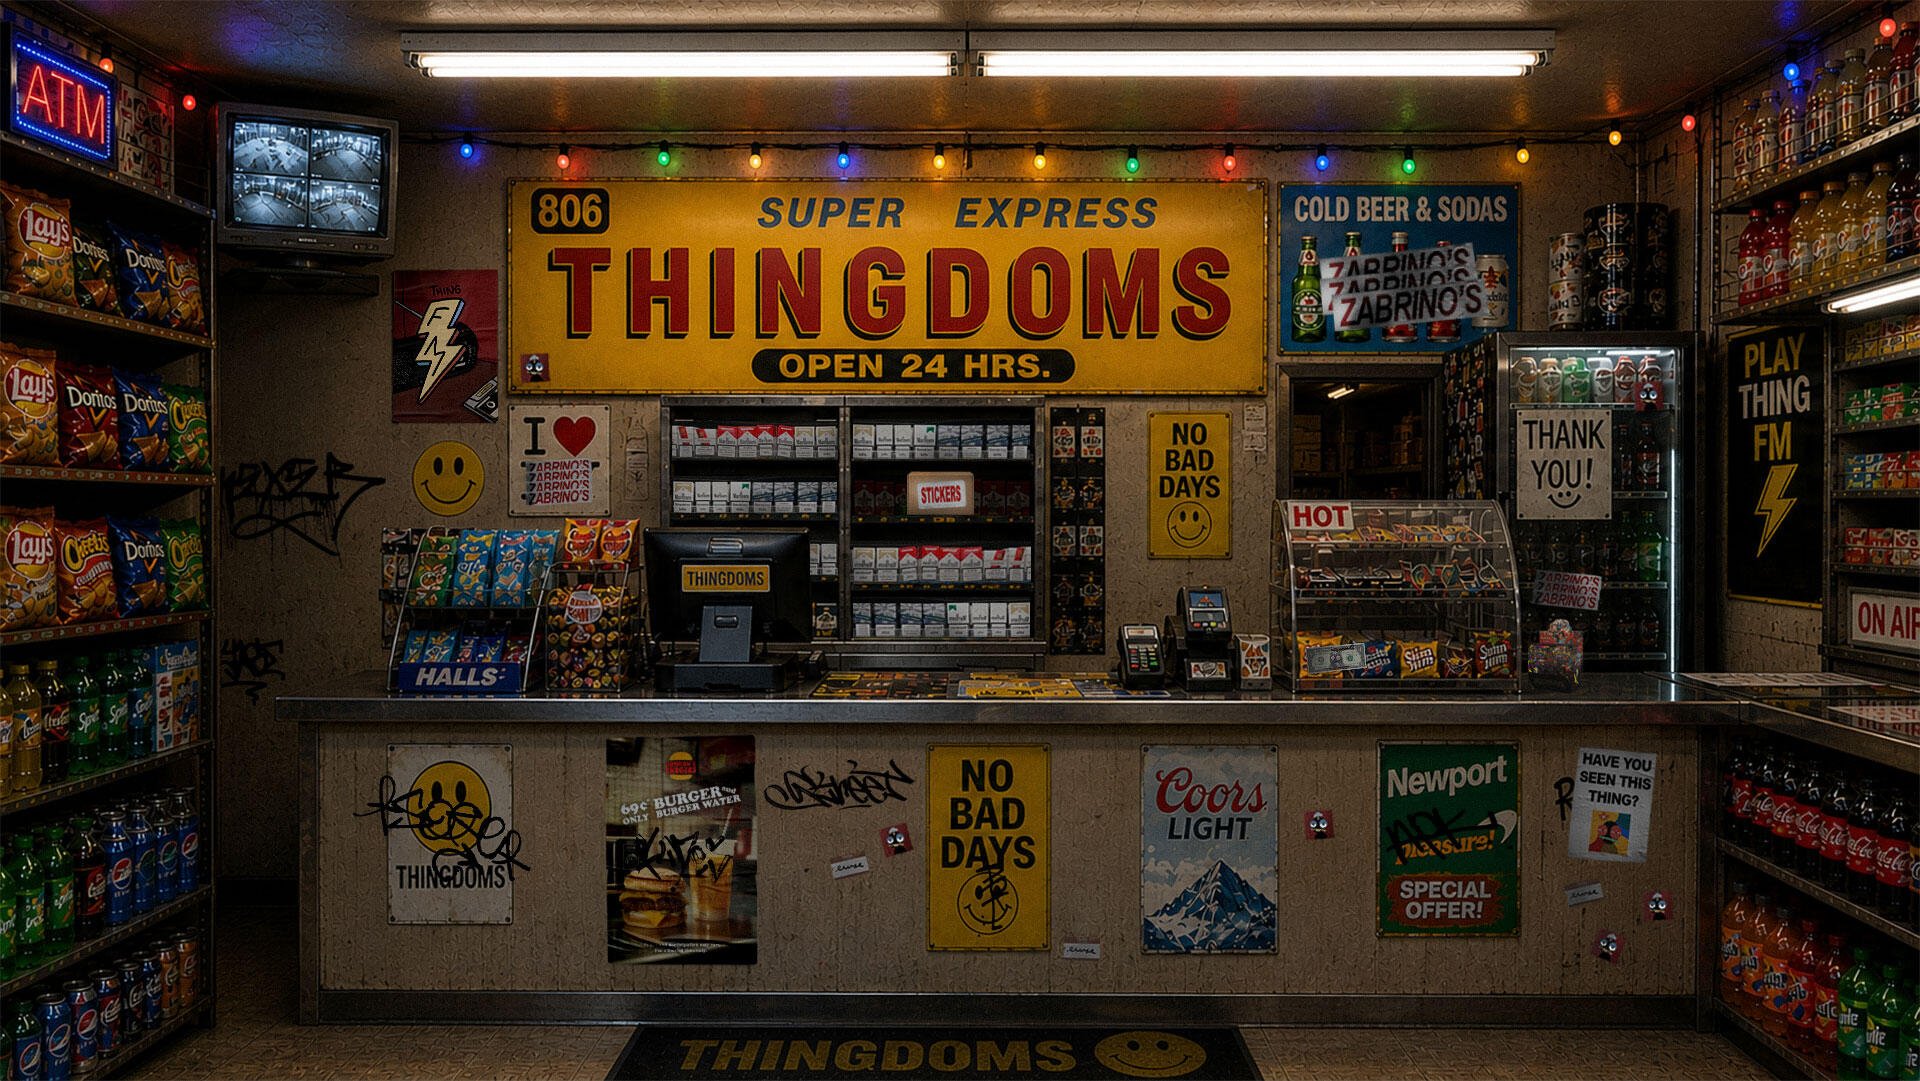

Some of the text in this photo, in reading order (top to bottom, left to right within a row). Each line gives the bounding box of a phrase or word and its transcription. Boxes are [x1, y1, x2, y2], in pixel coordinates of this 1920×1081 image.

[23, 65, 105, 144] ATM
[537, 193, 603, 228] 806
[757, 197, 1158, 228] SUPER EXPRESS
[1294, 195, 1508, 223] COLD BEER & SODAS
[430, 285, 462, 296] THING
[549, 246, 1231, 341] THINGDOMS
[1340, 283, 1482, 327] ZABRINO'S
[779, 354, 1051, 379] OPEN 24 HRS.
[1744, 332, 1806, 379] PLAY
[1738, 374, 1811, 420] THING
[523, 417, 546, 455] I
[1172, 422, 1208, 446] NO
[1523, 419, 1605, 450] THANK
[1754, 421, 1792, 462] FM
[1165, 449, 1214, 471] BAD
[1531, 458, 1593, 489] YOU!
[921, 485, 961, 504] STICKERS
[1159, 475, 1221, 498] DAYS
[1293, 506, 1349, 527] HOT
[687, 571, 764, 586] THINGDOMS
[1858, 601, 1885, 635] ON
[415, 667, 498, 687] HALLS
[961, 759, 1014, 792] NO
[1387, 756, 1508, 798] Newport
[1583, 753, 1652, 772] HAVE YOU
[1156, 767, 1267, 813] Coors
[1580, 771, 1652, 790] SEEN THIS
[621, 785, 737, 815] 69¢ BURGER and
[622, 794, 741, 825] ONLY BURGER WATER
[951, 798, 1025, 829] BAD
[1589, 790, 1639, 807] THING?
[1168, 817, 1252, 840] LIGHT
[941, 836, 1036, 868] DAYS
[396, 865, 506, 889] THINGDOMS
[1400, 880, 1492, 899] SPECIAL
[1405, 901, 1484, 920] OFFER!
[679, 1039, 1077, 1073] THINGDOMS
